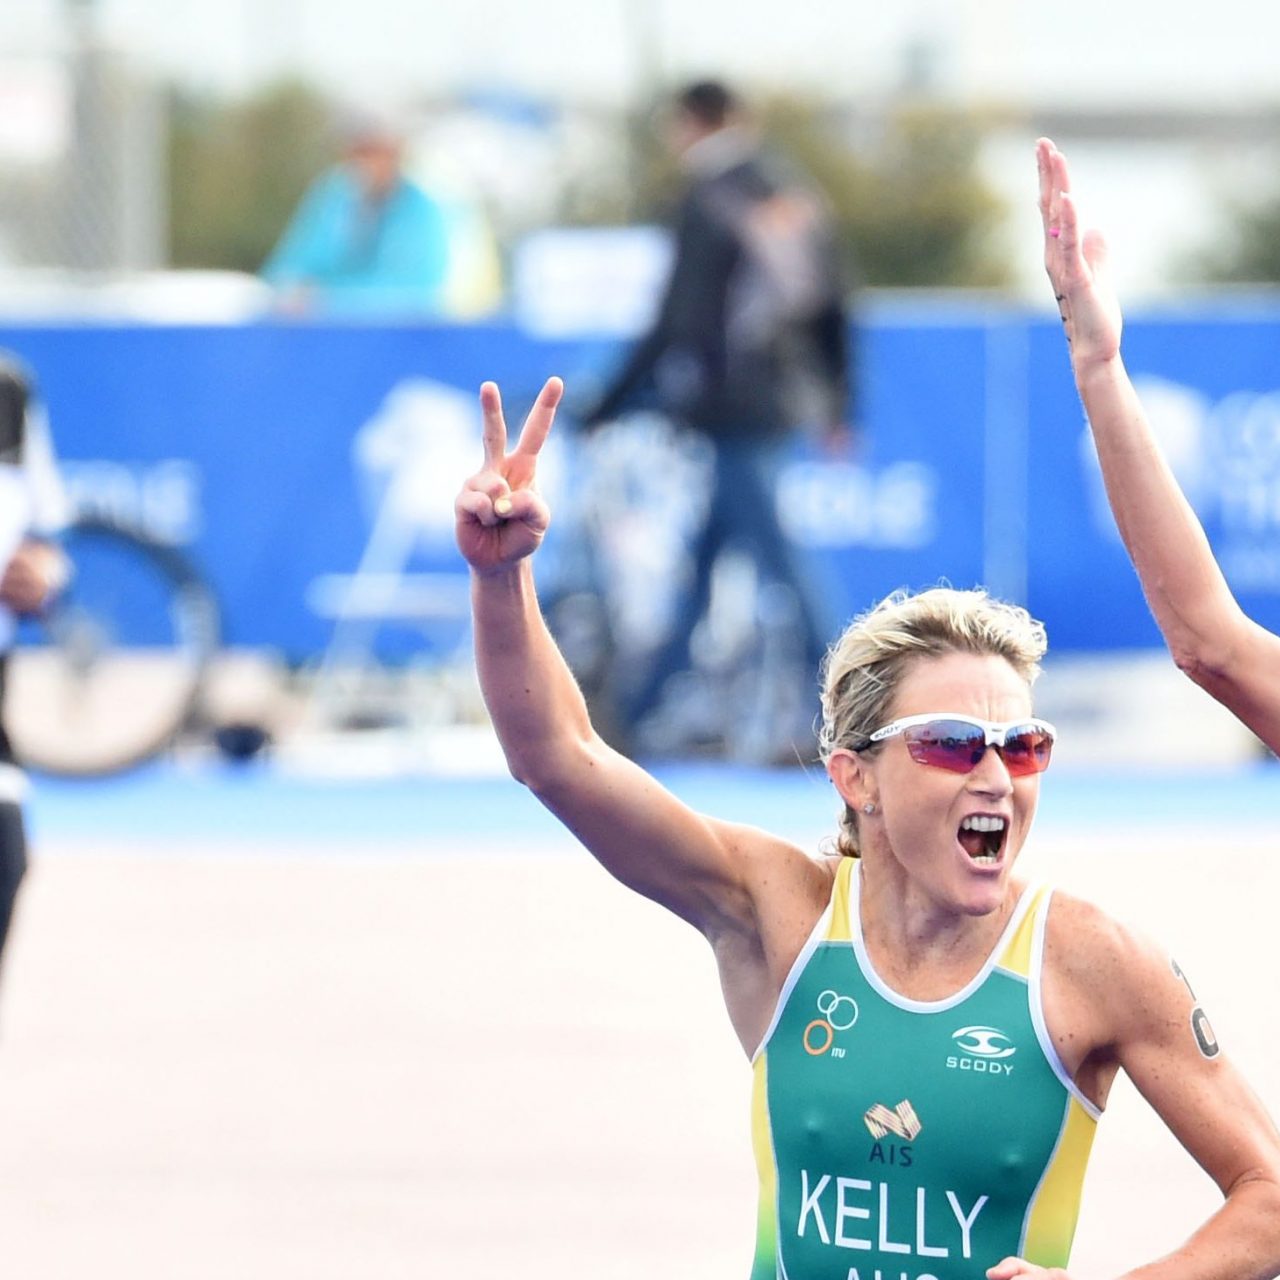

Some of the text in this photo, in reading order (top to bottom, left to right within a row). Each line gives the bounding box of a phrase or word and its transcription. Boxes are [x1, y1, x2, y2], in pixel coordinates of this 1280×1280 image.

[831, 1047, 846, 1059] ITU
[946, 1055, 1014, 1076] SCODY
[869, 1142, 913, 1168] AIS
[797, 1169, 989, 1259] KELLY
